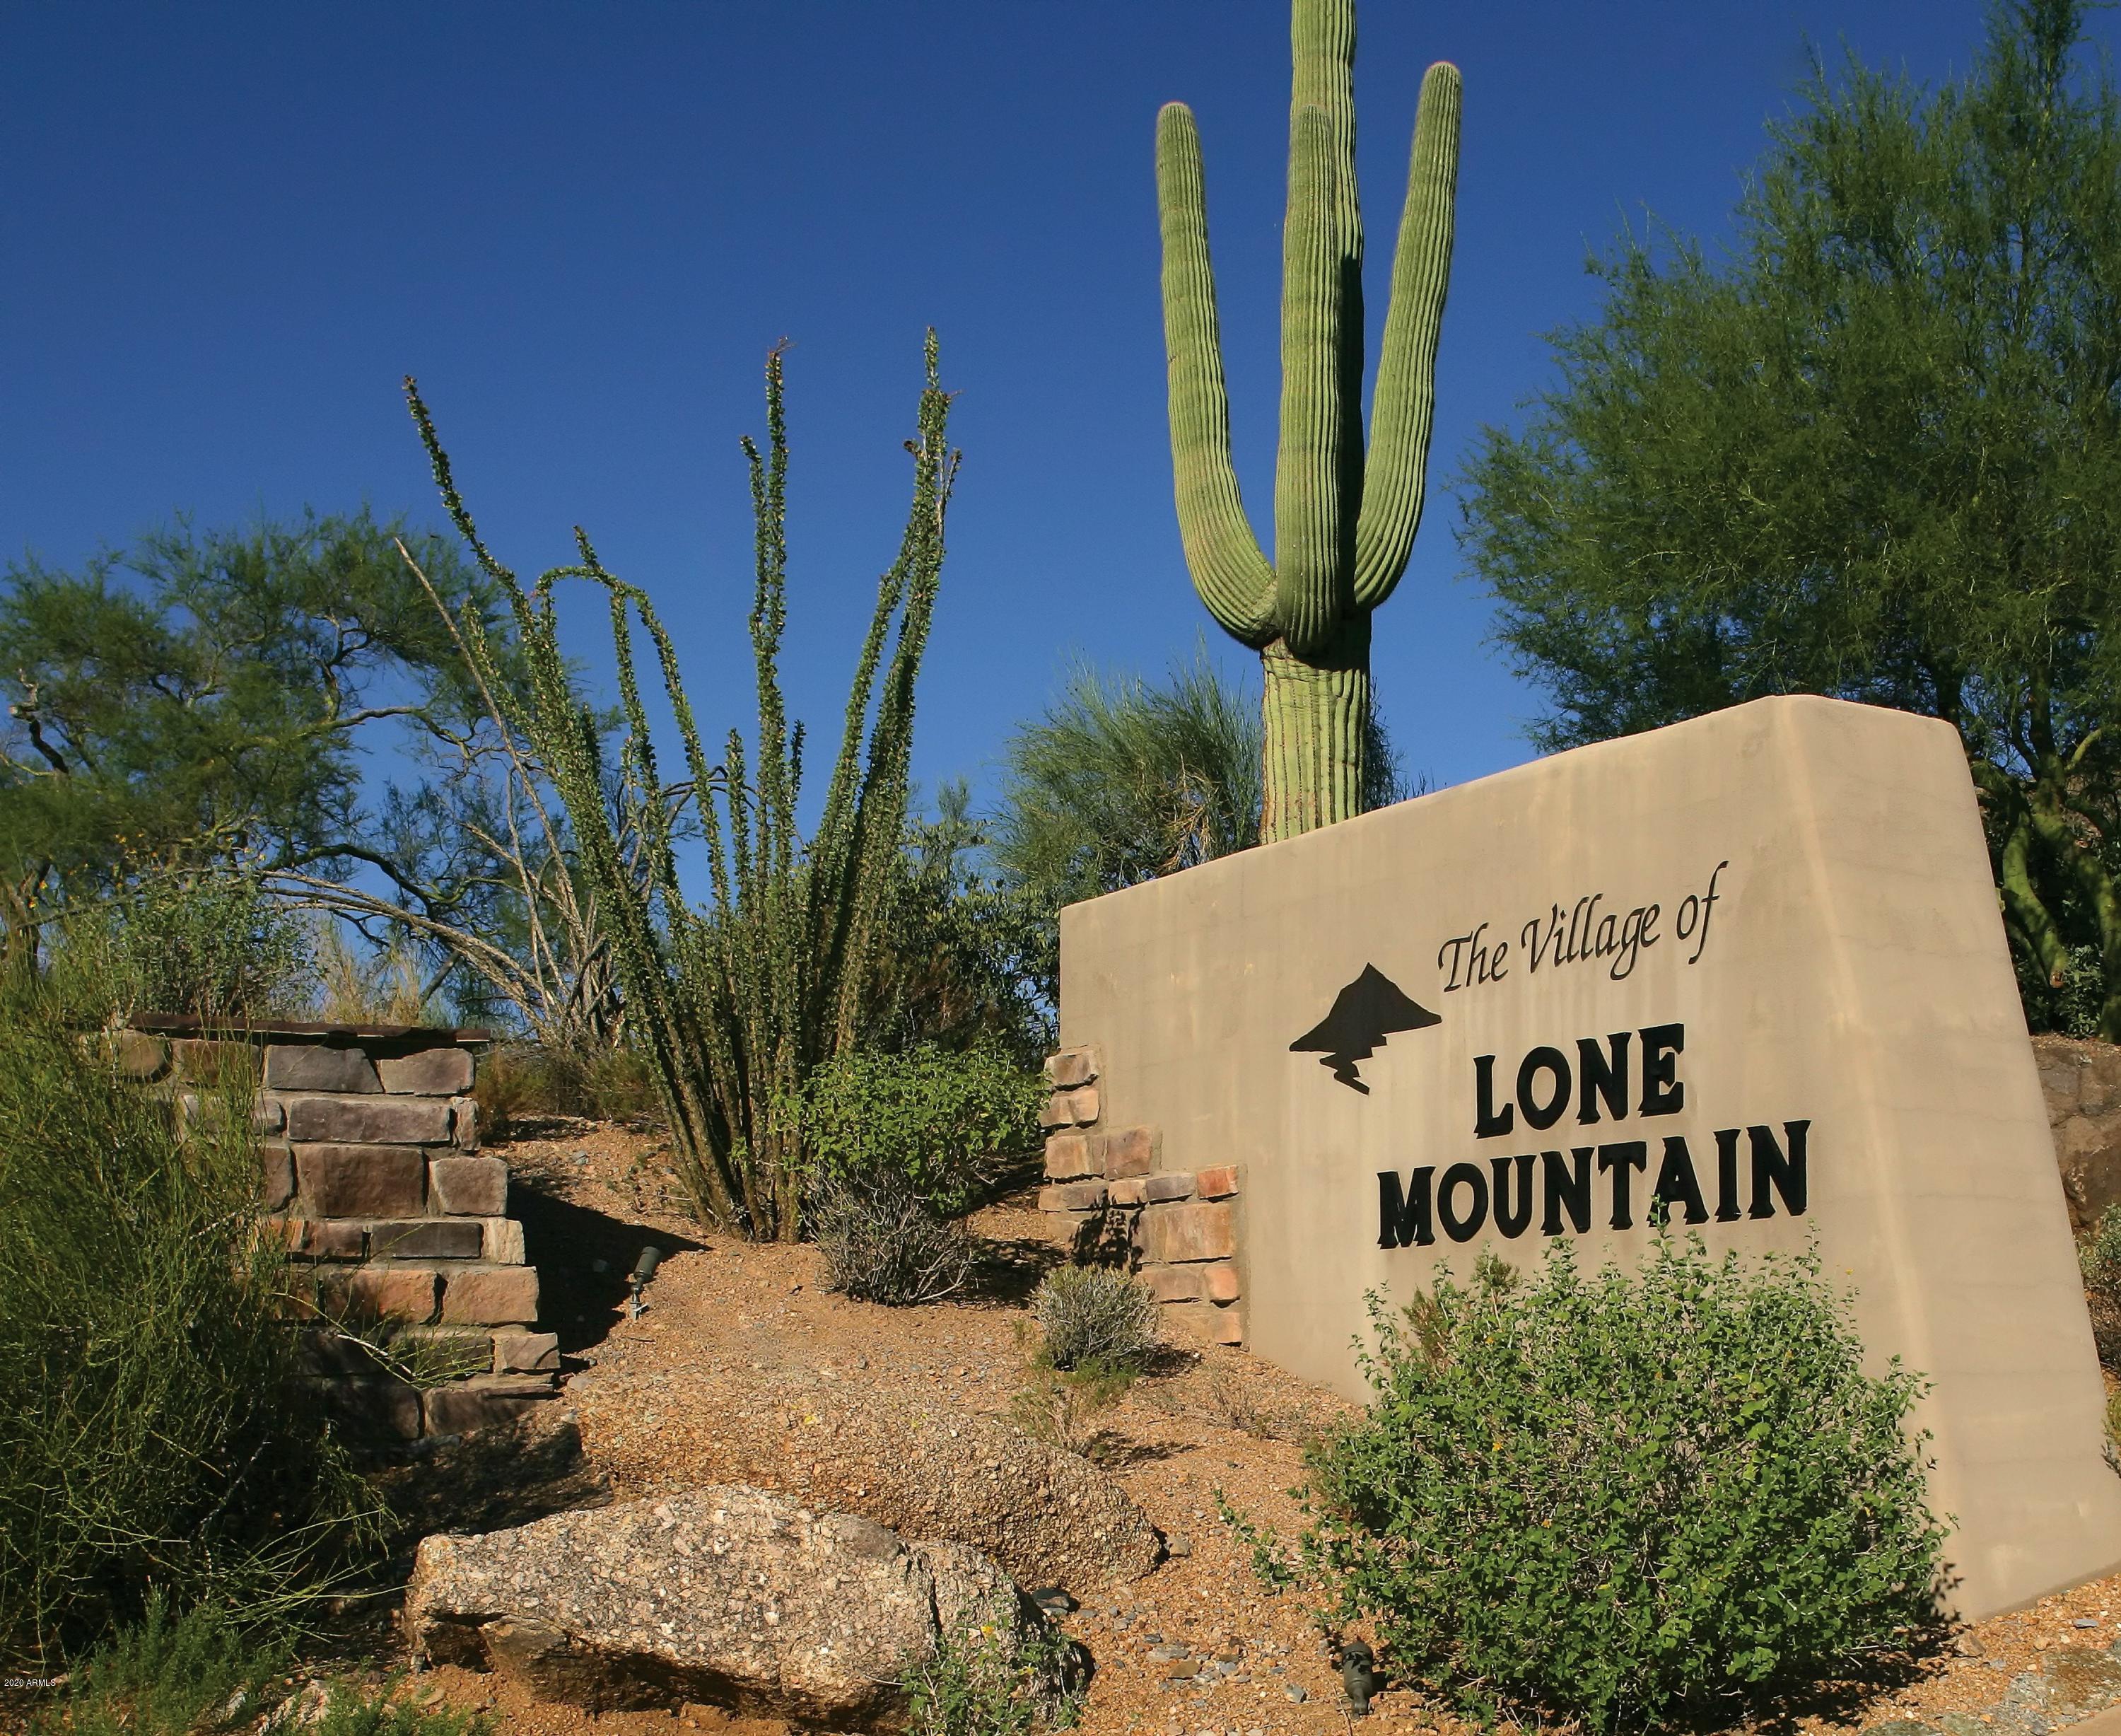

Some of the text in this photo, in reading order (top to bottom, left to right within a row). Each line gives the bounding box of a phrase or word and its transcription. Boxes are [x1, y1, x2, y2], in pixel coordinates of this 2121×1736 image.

[1438, 860, 1729, 993] The Village of
[1473, 1023, 1685, 1139] LONE
[1377, 1119, 1812, 1249] MOUNTAIN
